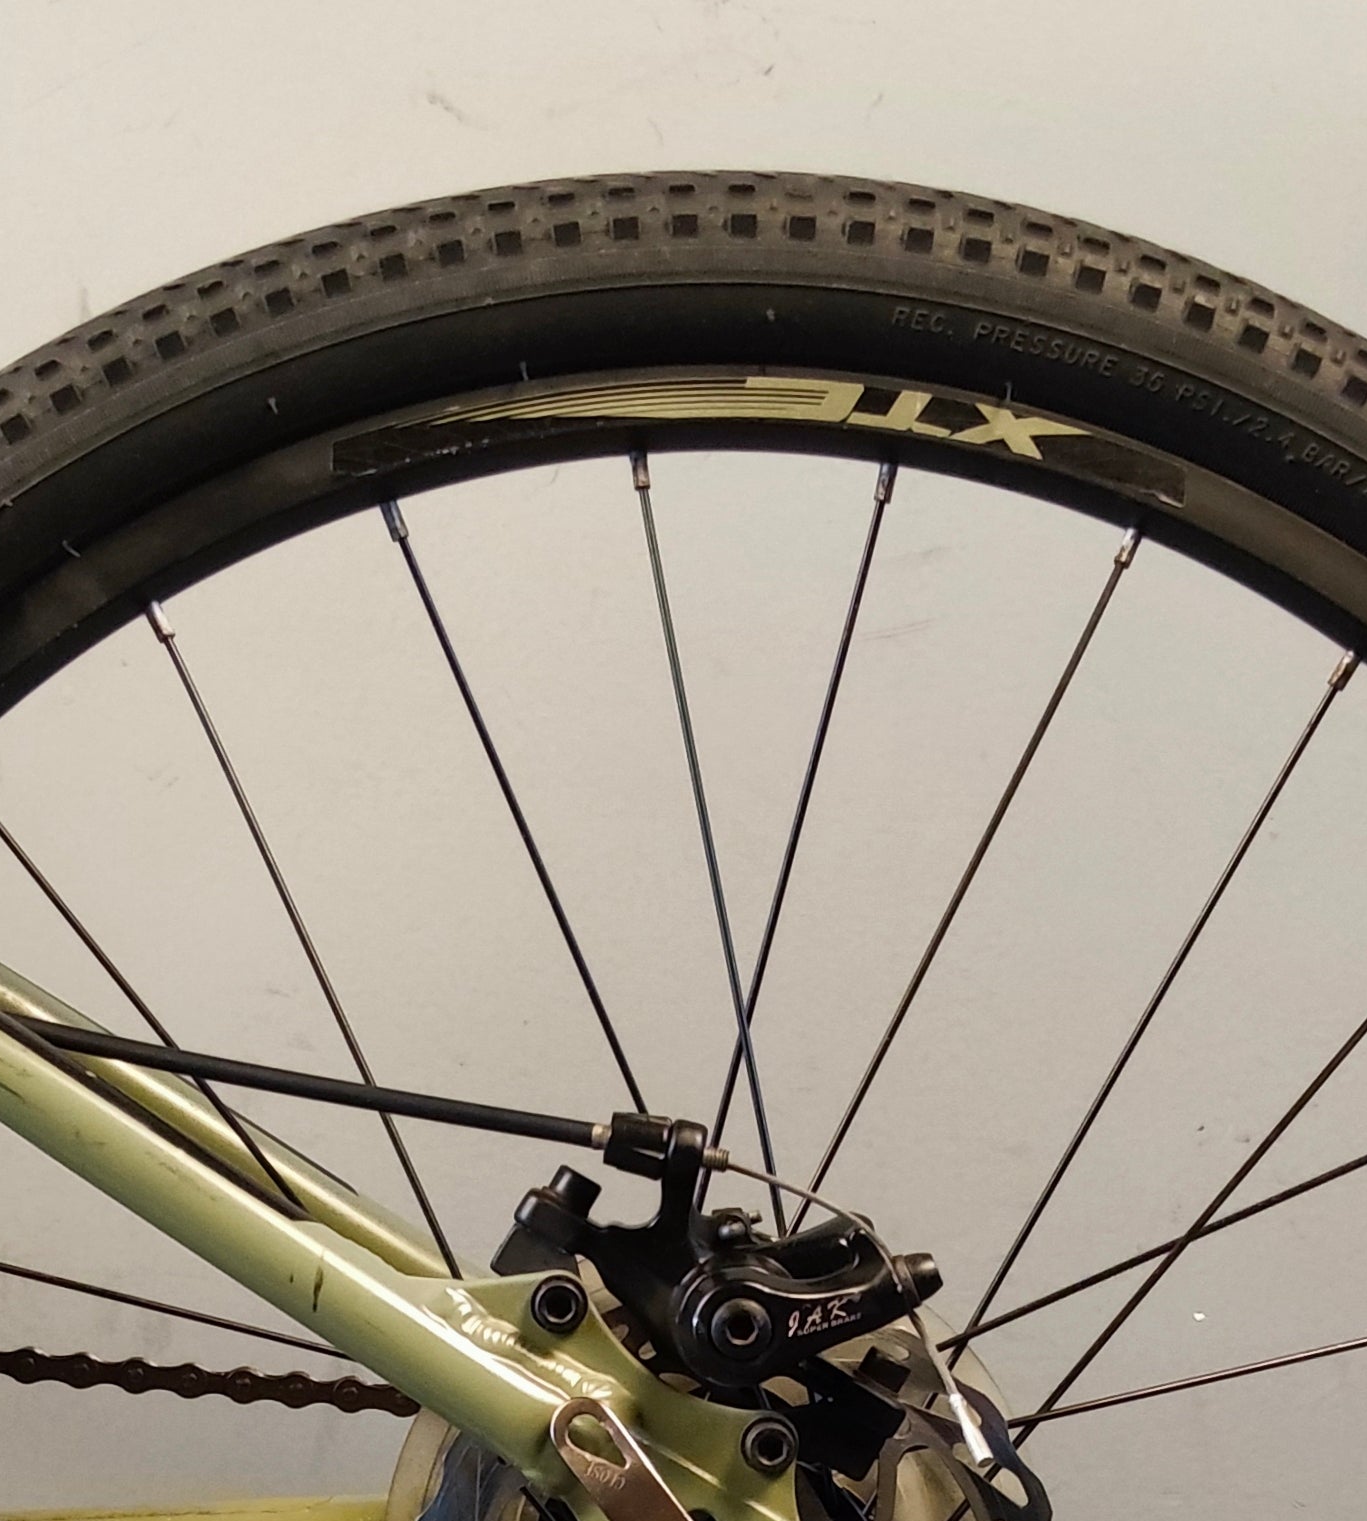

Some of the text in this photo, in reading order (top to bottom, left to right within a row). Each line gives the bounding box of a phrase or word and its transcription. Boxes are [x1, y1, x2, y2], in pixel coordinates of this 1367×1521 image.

[892, 305, 954, 336] REC.
[973, 320, 1120, 378] PRESSURE
[744, 378, 1092, 460] XTC
